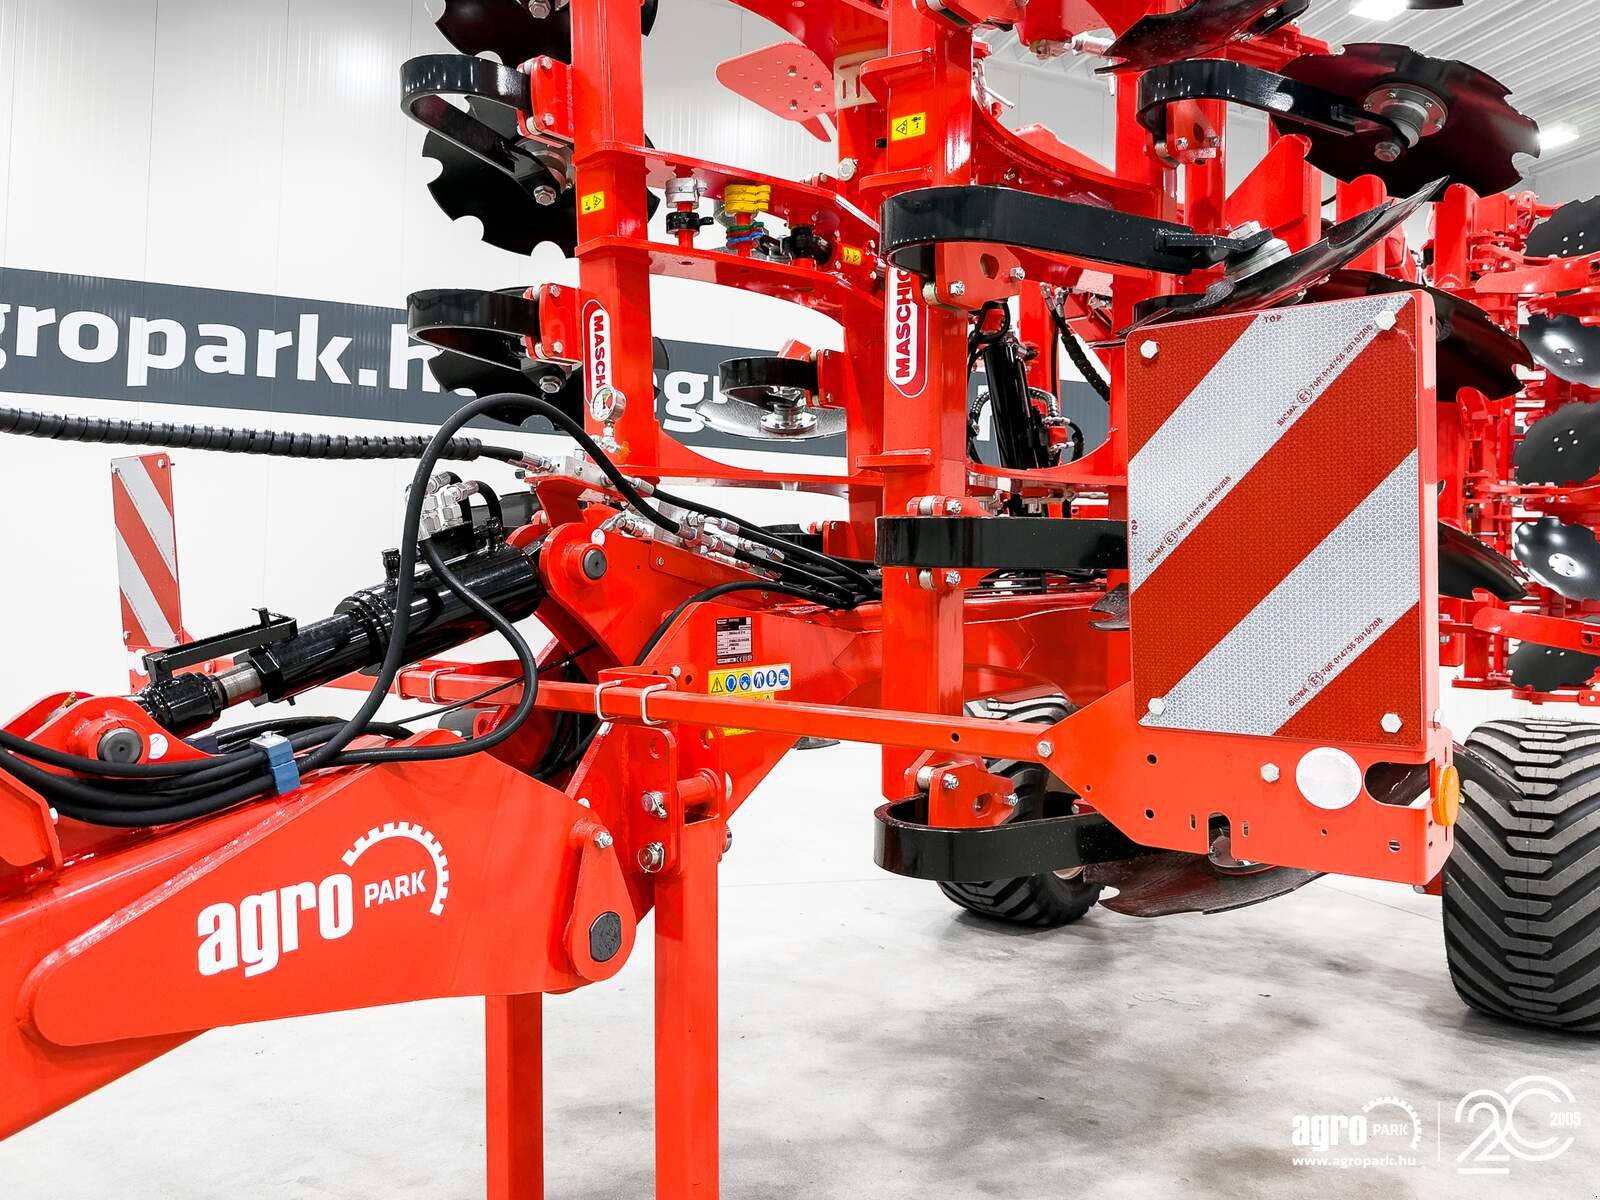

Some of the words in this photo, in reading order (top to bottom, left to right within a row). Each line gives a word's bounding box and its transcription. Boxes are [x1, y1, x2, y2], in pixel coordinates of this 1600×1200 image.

[0, 303, 477, 397] ropark.h
[593, 314, 606, 390] MASCH
[1263, 314, 1282, 323] TOP
[197, 873, 354, 978] agro
[364, 869, 427, 909] PARK
